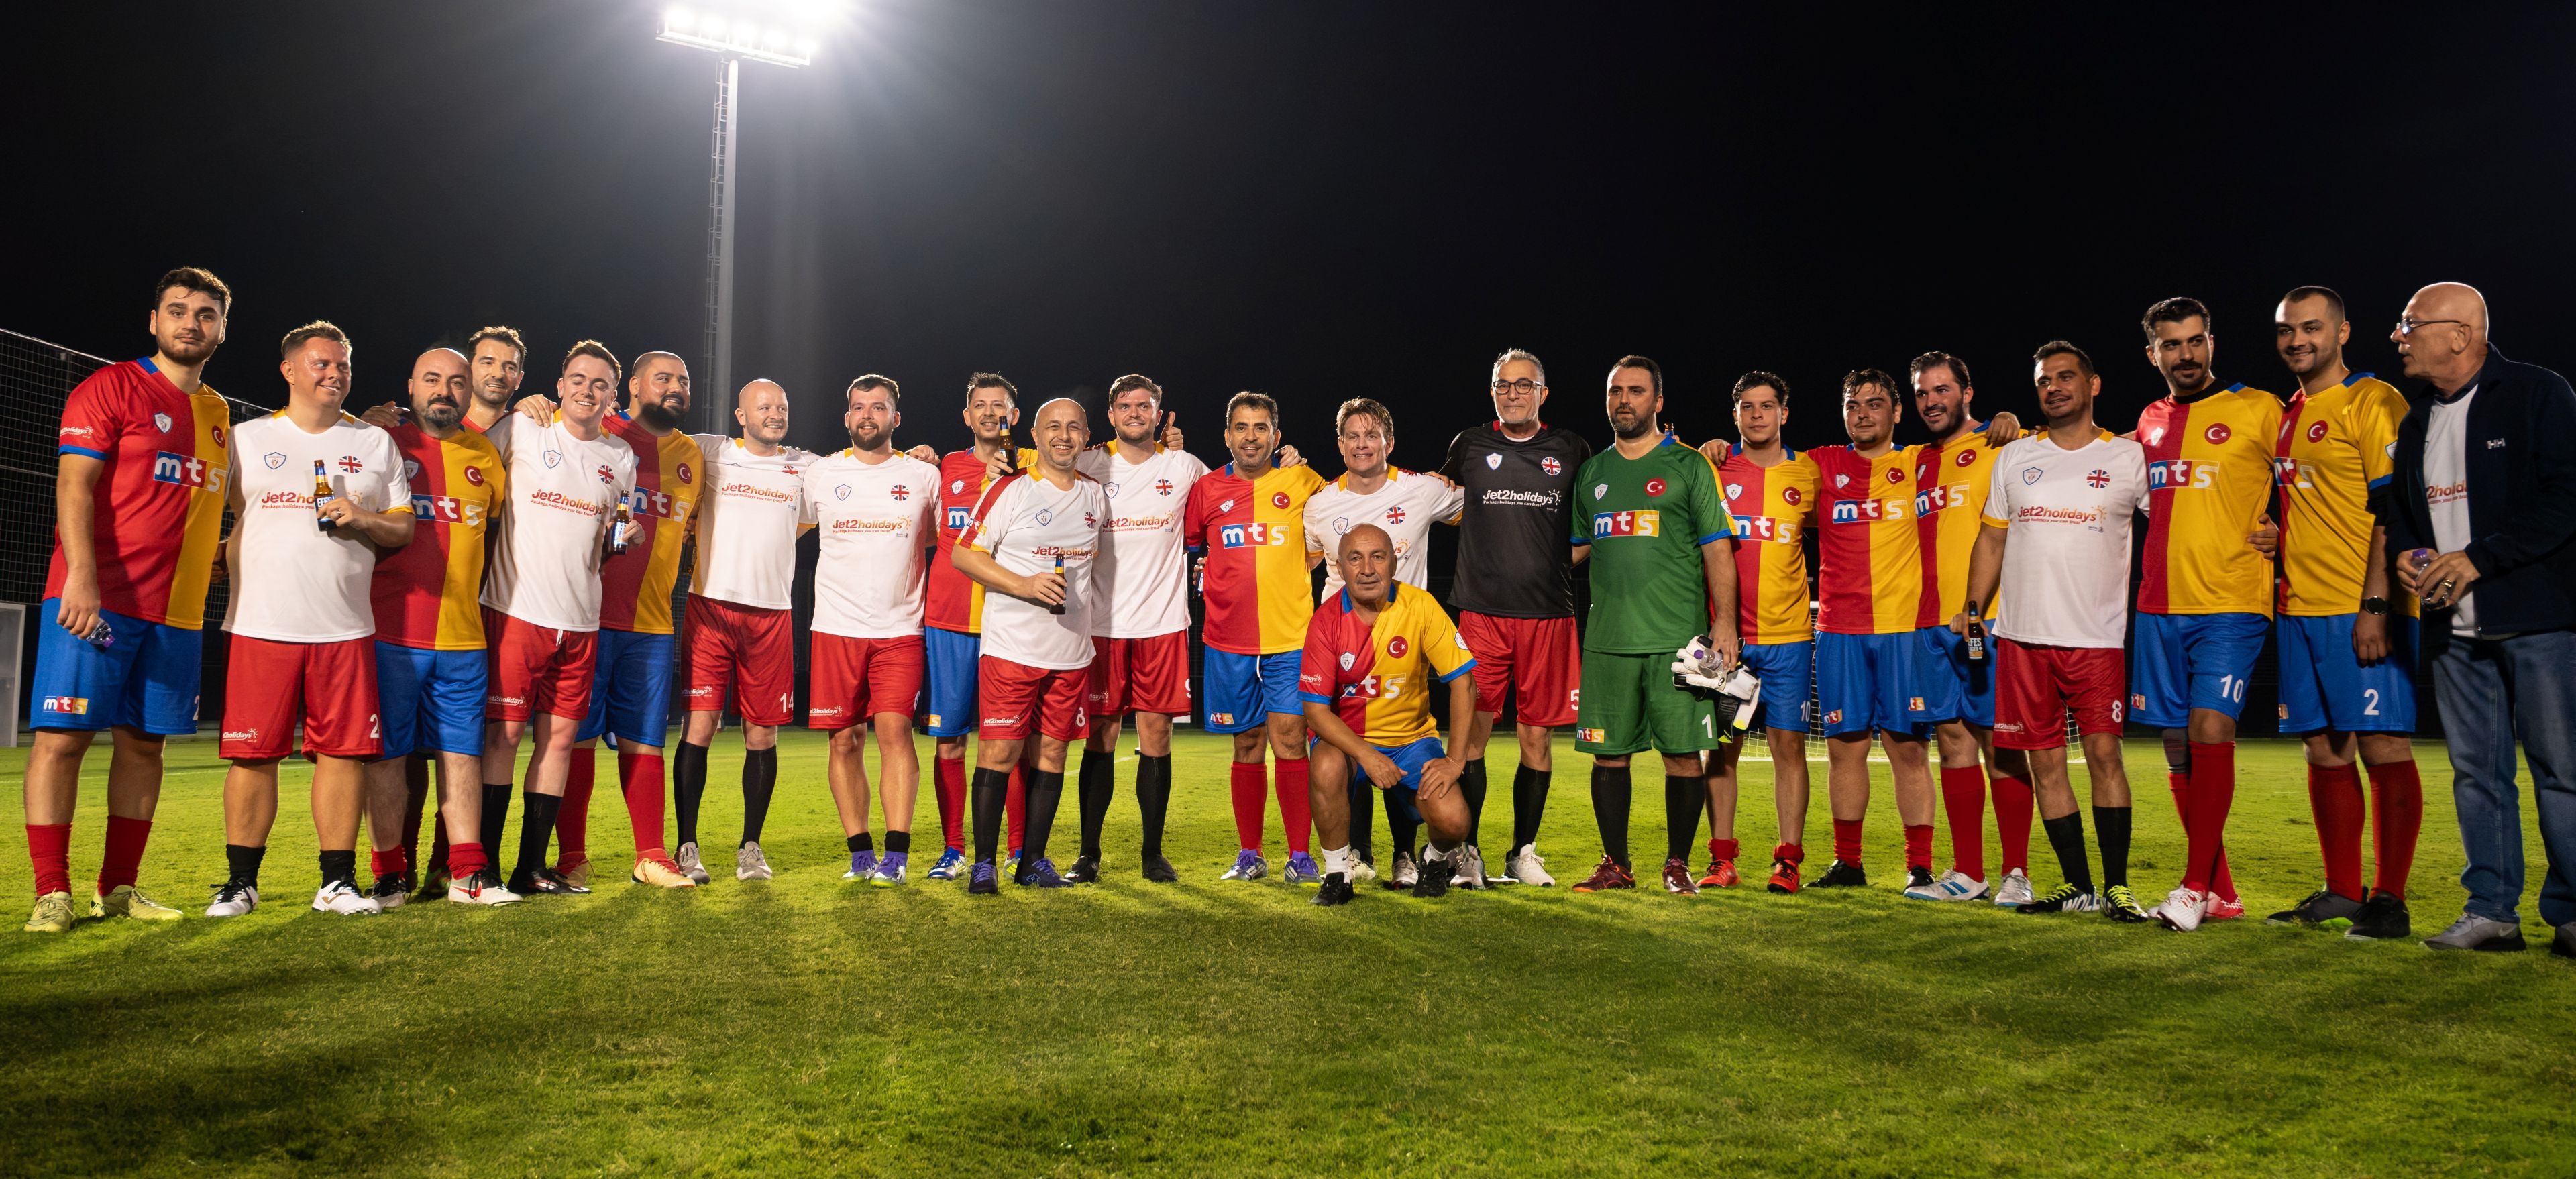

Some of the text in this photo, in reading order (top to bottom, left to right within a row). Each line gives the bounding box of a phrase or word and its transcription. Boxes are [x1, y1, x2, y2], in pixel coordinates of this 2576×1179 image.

[2487, 437, 2506, 449] HH
[155, 457, 227, 492] mts
[2149, 459, 2219, 488] mts
[262, 492, 315, 504] Jet2ho
[1915, 484, 1970, 513] mts
[2427, 479, 2466, 499] 2holid
[1833, 498, 1907, 520] mts
[1222, 523, 1289, 545] mts
[1595, 512, 1659, 536] mts
[1736, 516, 1796, 543] mts
[1570, 689, 1579, 710] 5
[2220, 674, 2243, 703] 10
[44, 697, 87, 714] mts
[1800, 701, 1811, 722] 10
[1908, 697, 1925, 711] ts
[2112, 699, 2122, 723] 8
[2364, 689, 2379, 715] 2
[370, 714, 380, 738] 2
[1075, 706, 1086, 727] 8
[1701, 714, 1713, 738] 1
[1577, 728, 1605, 743] mts
